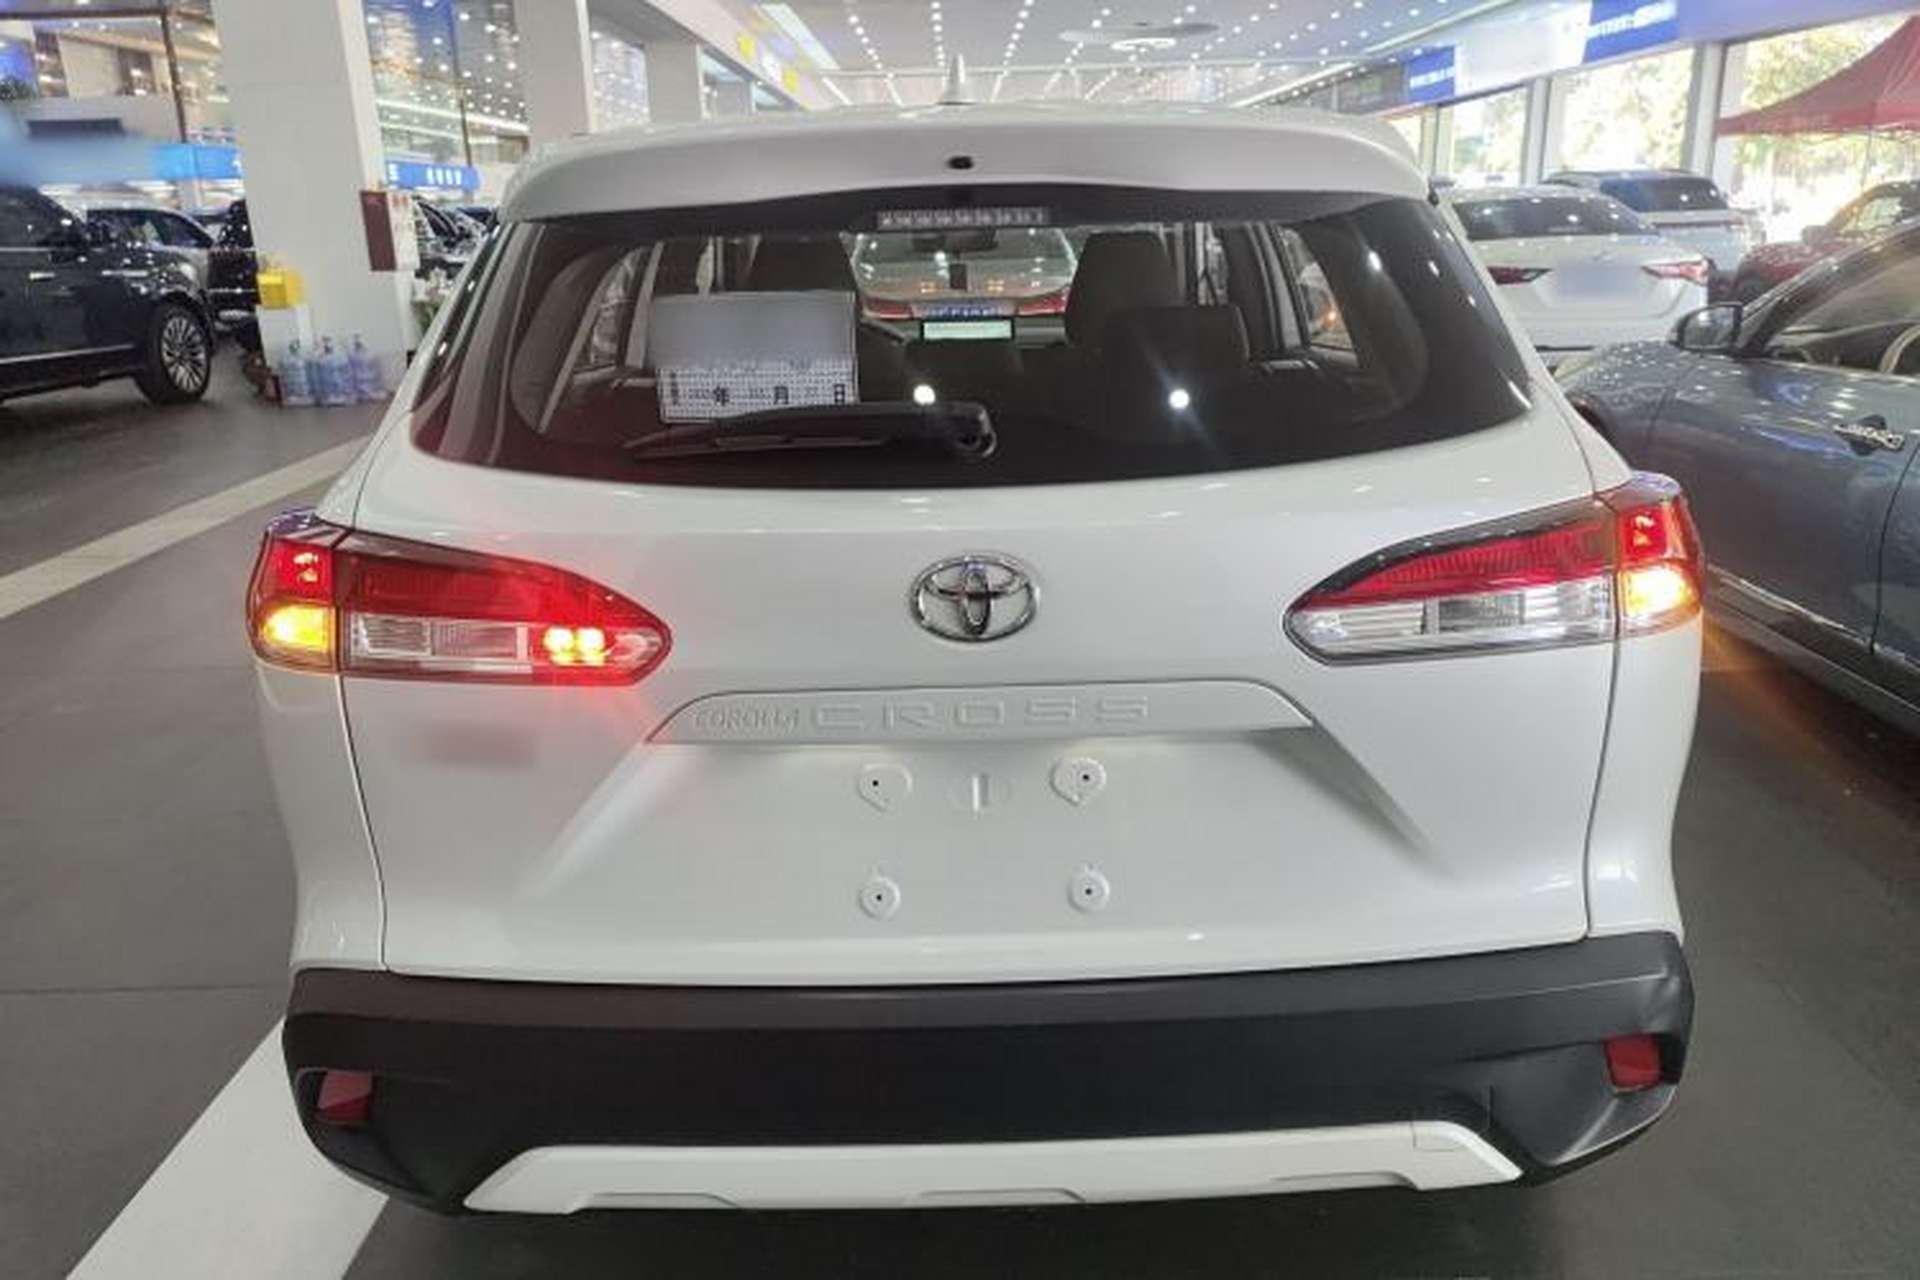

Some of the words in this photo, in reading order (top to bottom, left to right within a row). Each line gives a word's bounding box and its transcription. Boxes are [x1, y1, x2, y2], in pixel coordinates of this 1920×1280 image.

[714, 385, 731, 407] 年
[773, 386, 790, 406] 月
[834, 383, 847, 405] 日
[694, 707, 799, 732] COROLLA
[811, 697, 1150, 731] CROSS
